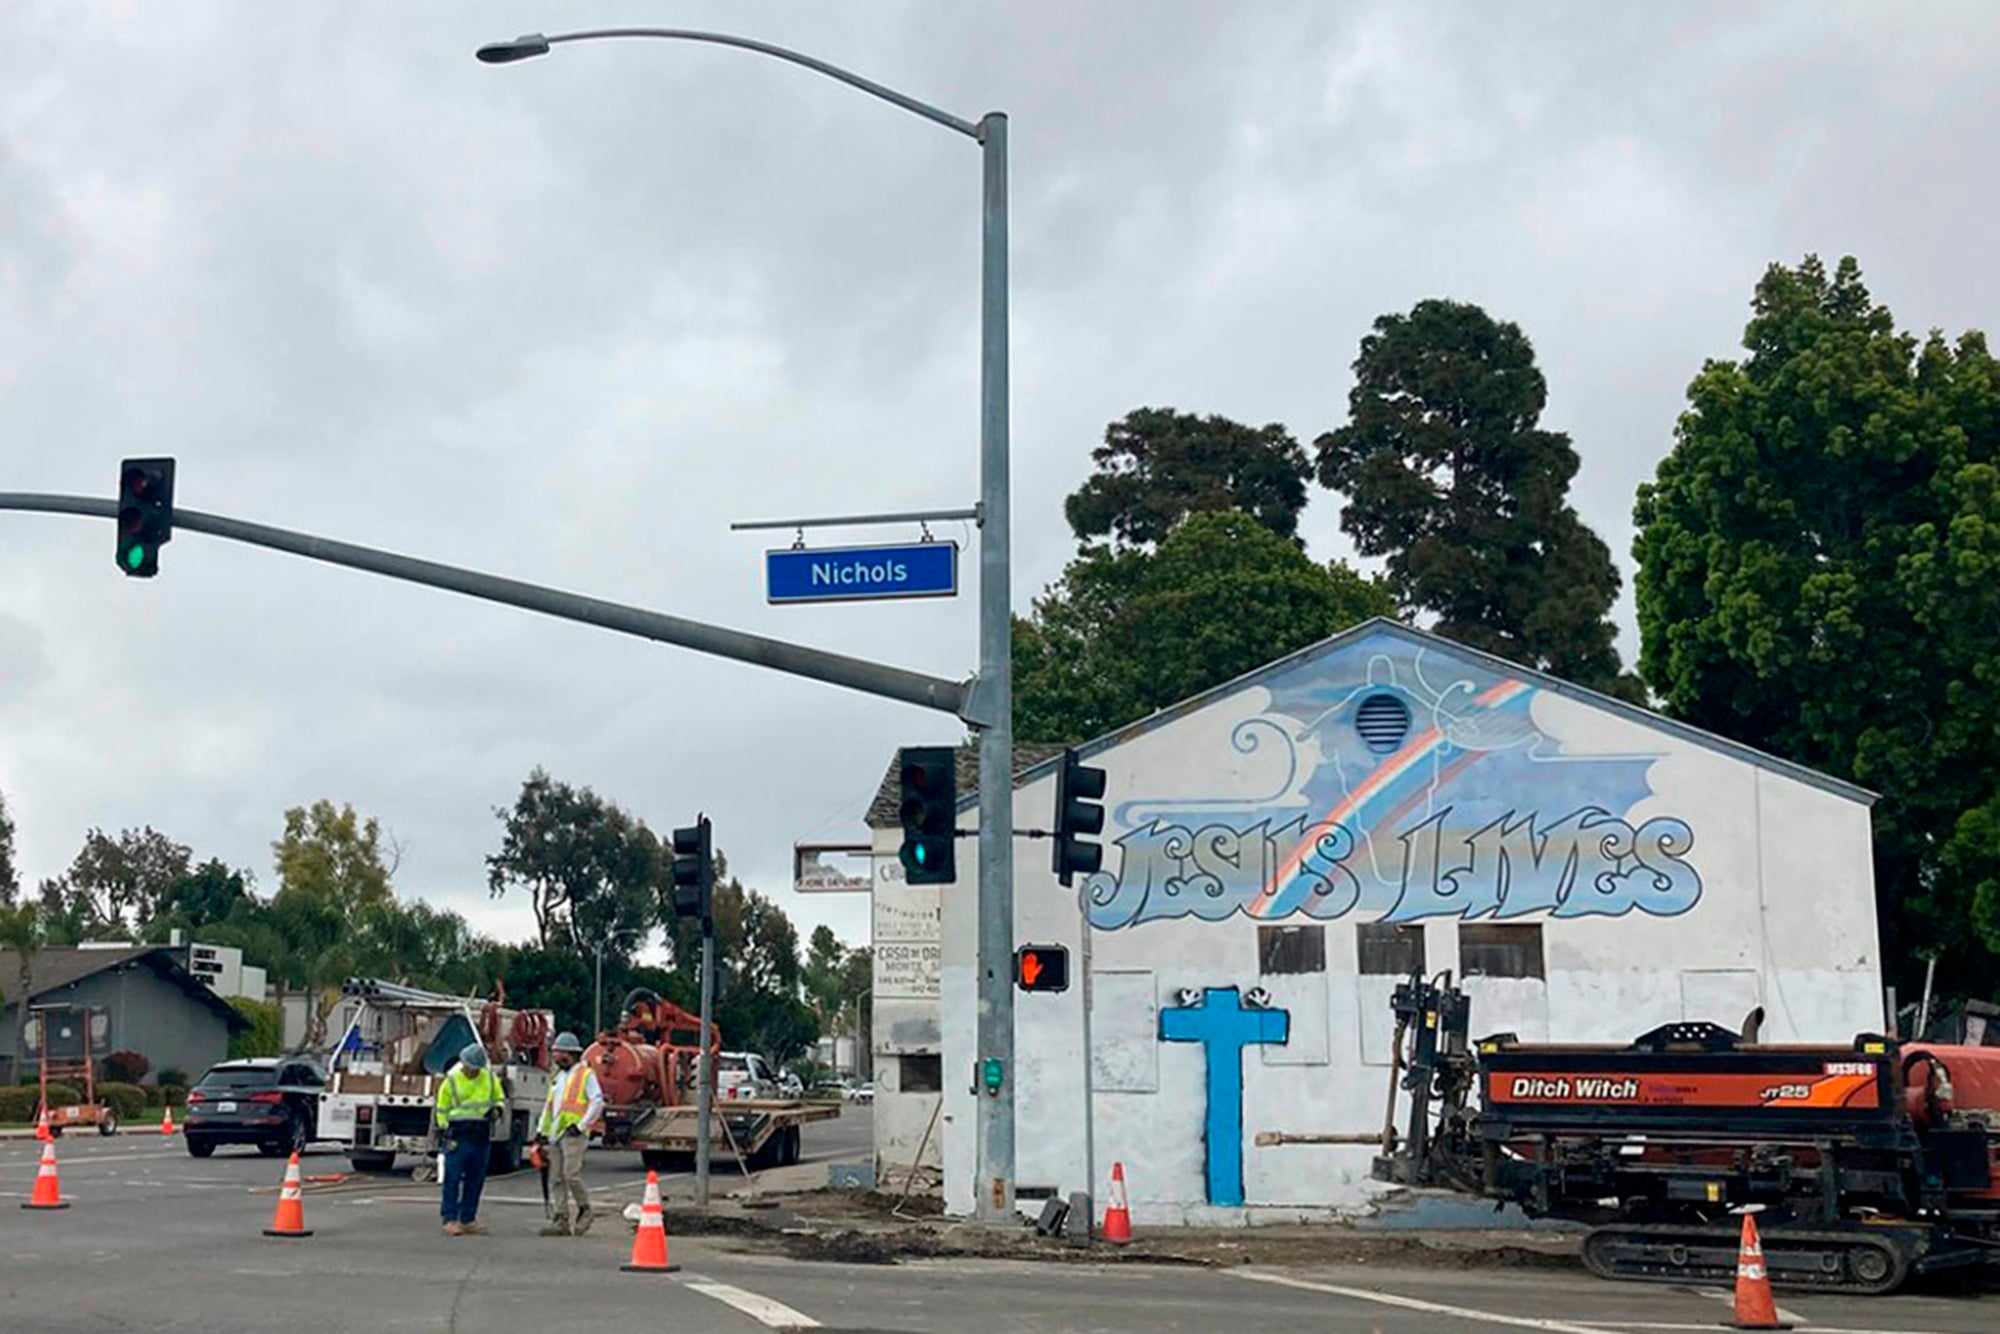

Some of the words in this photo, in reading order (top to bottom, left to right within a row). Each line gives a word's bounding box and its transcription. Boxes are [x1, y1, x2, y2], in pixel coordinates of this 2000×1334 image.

[812, 559, 908, 586] Nichols
[1080, 814, 1361, 931] JESUS
[1378, 805, 1704, 925] LIVES
[1511, 1077, 1571, 1099] Ditch
[1574, 1077, 1639, 1099] Witch
[1760, 1084, 1810, 1100] JT25
